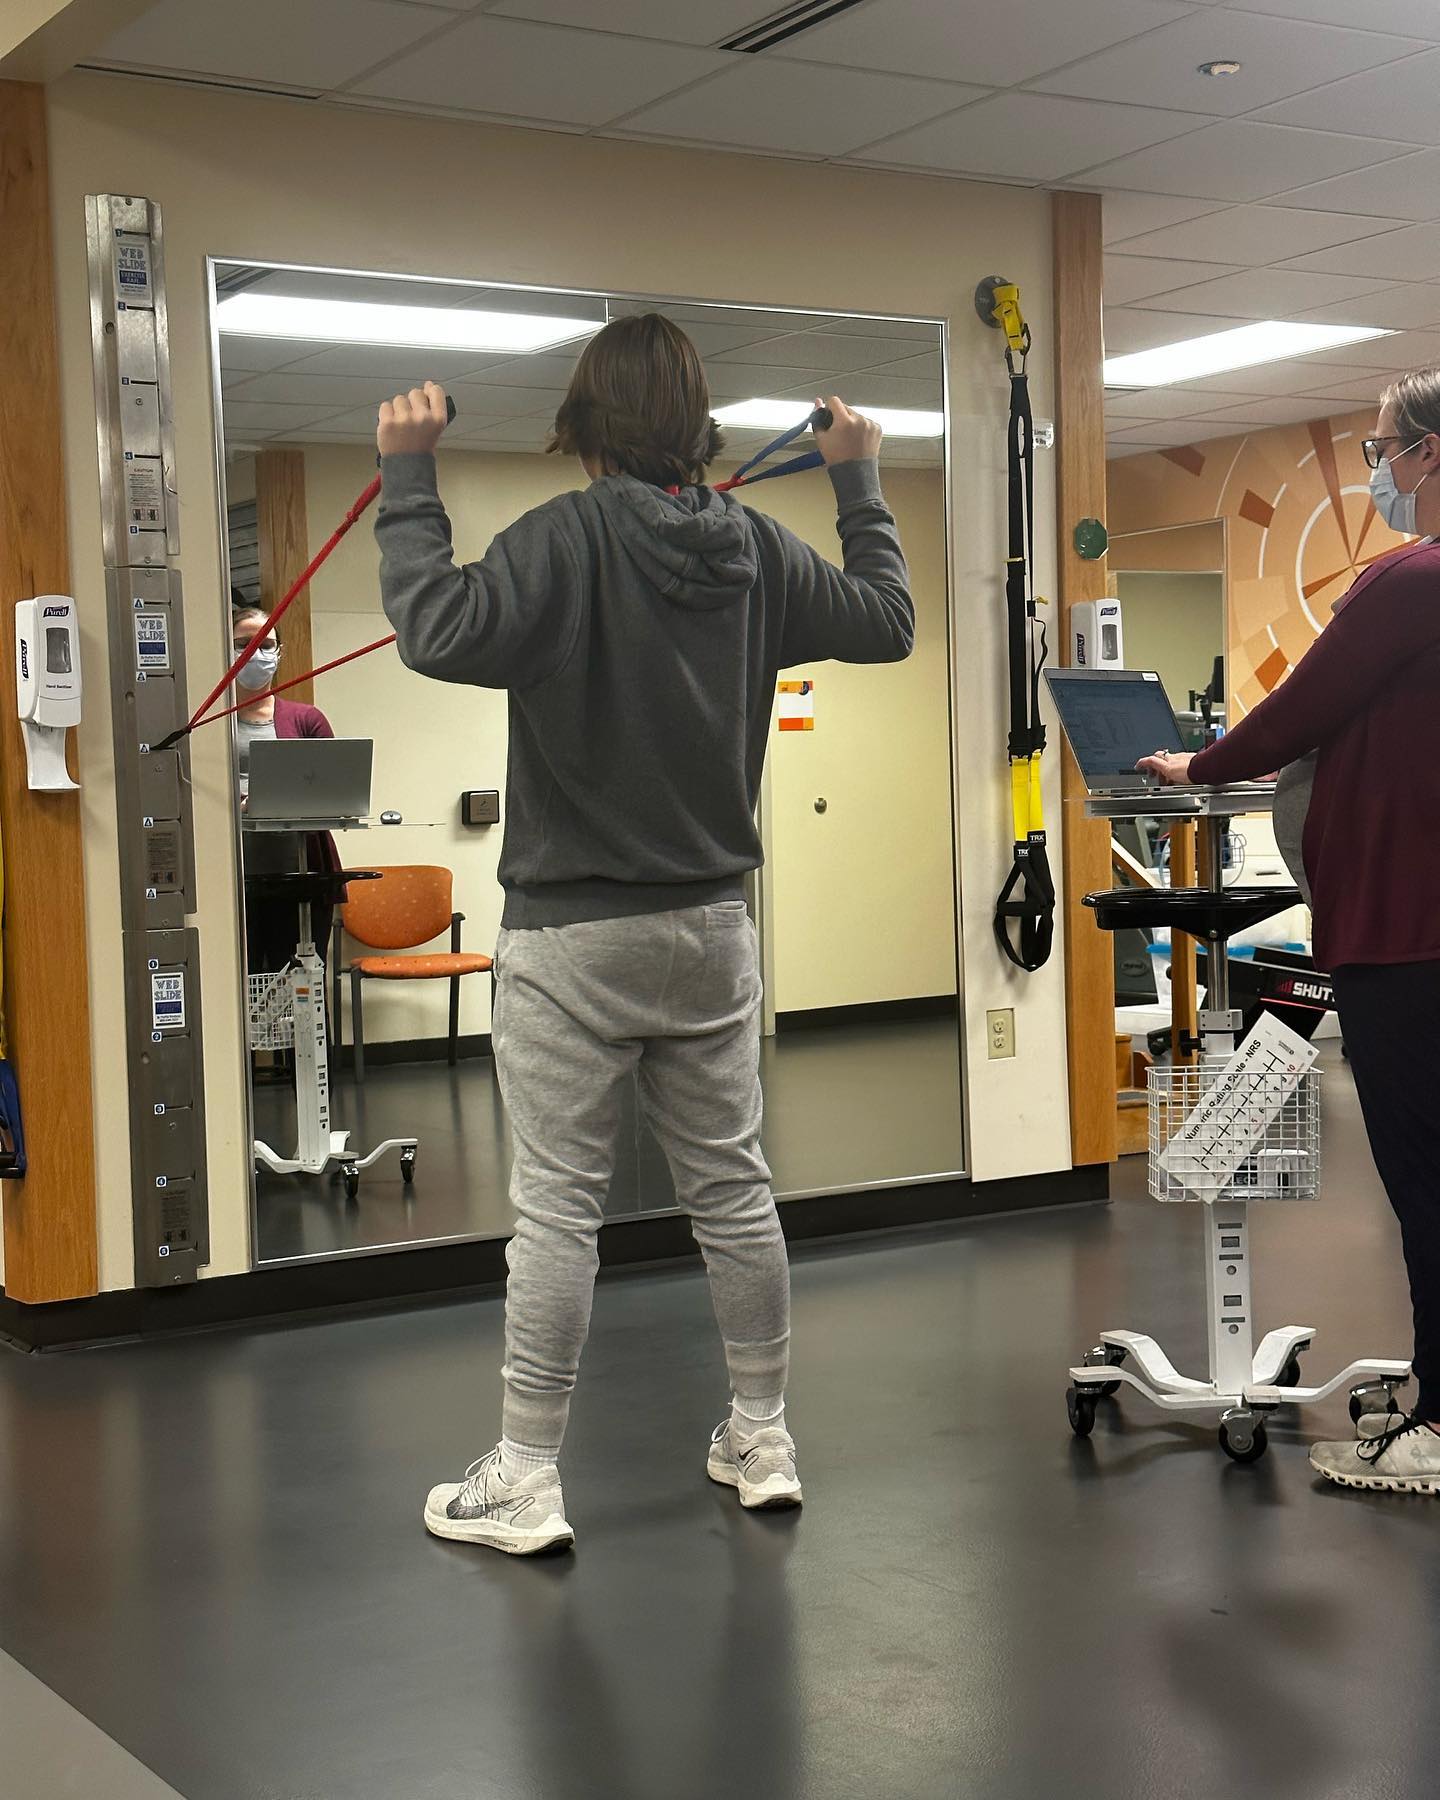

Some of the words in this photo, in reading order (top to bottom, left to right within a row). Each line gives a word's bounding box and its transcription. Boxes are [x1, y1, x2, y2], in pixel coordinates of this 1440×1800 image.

[118, 260, 146, 270] SLIDE
[140, 620, 163, 630] WEB
[138, 631, 165, 640] SLIDE
[156, 980, 179, 990] WEB
[154, 991, 181, 1000] SLIDE
[1292, 982, 1335, 1003] SHUT
[1185, 1110, 1212, 1142] Numric
[1245, 1039, 1262, 1058] NRS
